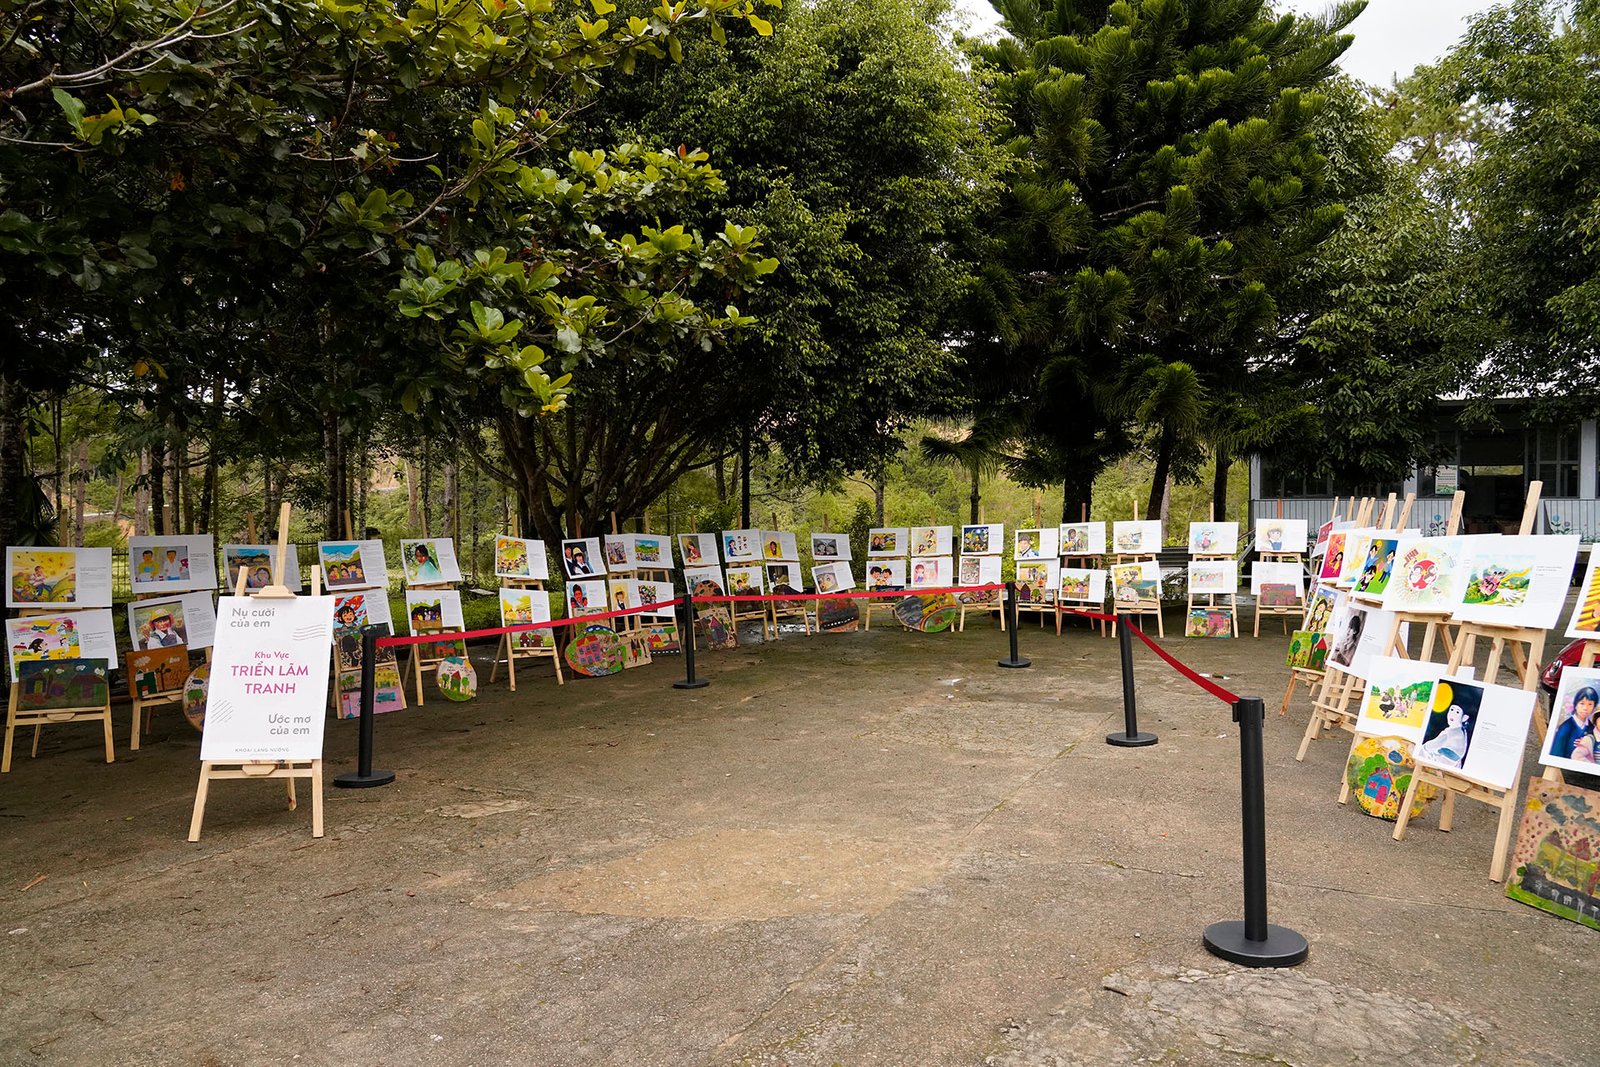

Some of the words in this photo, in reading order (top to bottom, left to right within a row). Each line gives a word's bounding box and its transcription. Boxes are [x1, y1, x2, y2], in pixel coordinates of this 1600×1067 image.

[232, 608, 248, 619] Nụ
[251, 607, 275, 617] cười
[230, 619, 250, 628] của
[274, 651, 290, 660] Vực
[231, 661, 274, 676] TRIỂN
[279, 662, 309, 676] LÃM
[245, 683, 296, 694] TRANH
[268, 713, 291, 724] Ước
[293, 715, 312, 724] mơ
[270, 726, 290, 735] của
[292, 727, 310, 735] em
